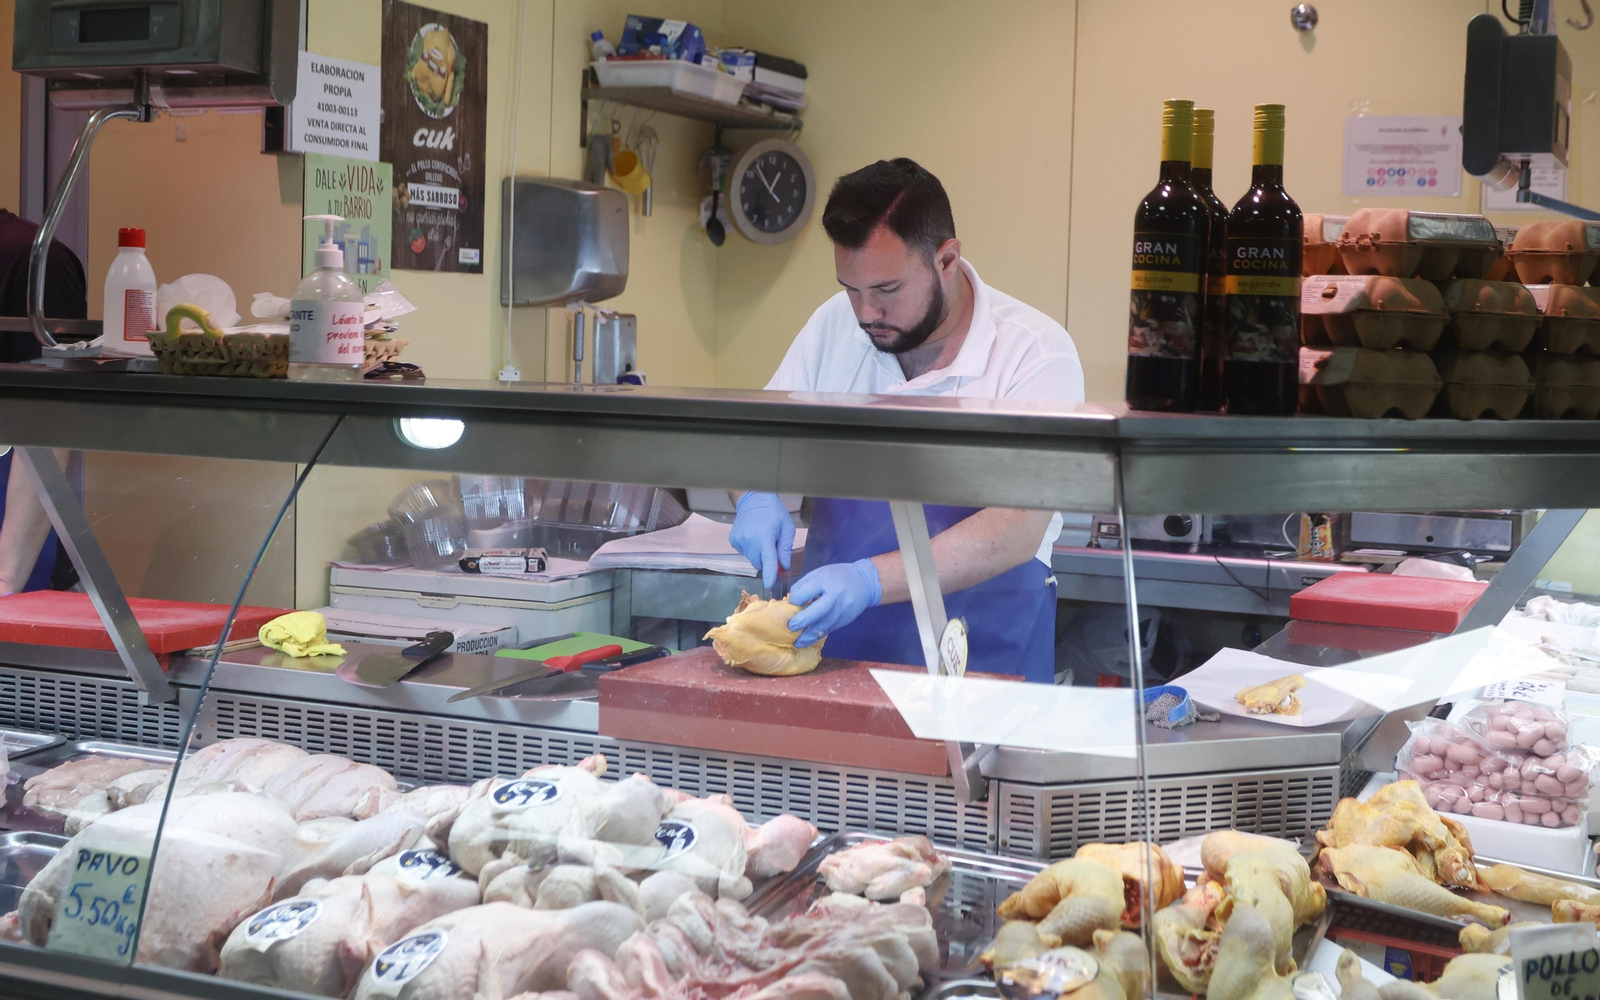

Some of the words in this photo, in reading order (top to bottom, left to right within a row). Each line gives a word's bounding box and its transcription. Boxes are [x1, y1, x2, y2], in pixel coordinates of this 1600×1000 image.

[311, 61, 365, 82] ELABORACION
[323, 83, 352, 98] PROPIA
[307, 117, 329, 130] VENTA
[330, 121, 357, 134] DIRECTA
[358, 126, 366, 136] AL
[304, 133, 350, 149] CONSUMIDOR
[351, 140, 369, 152] FINAL
[413, 126, 456, 151] cuk
[315, 167, 337, 190] DALE
[346, 164, 376, 196] VIDA
[410, 187, 425, 202] MÁS
[427, 191, 458, 206] SABROSO
[343, 195, 372, 220] BARRIO
[1135, 241, 1177, 255] GRAN
[1237, 246, 1284, 260] GRAN
[1133, 254, 1181, 266] COCINA
[1233, 259, 1288, 270] COCINA
[456, 635, 499, 653] PRODUCCION
[76, 848, 139, 876] PAVO
[1525, 946, 1600, 984] POLLO
[1550, 977, 1576, 997] DE
